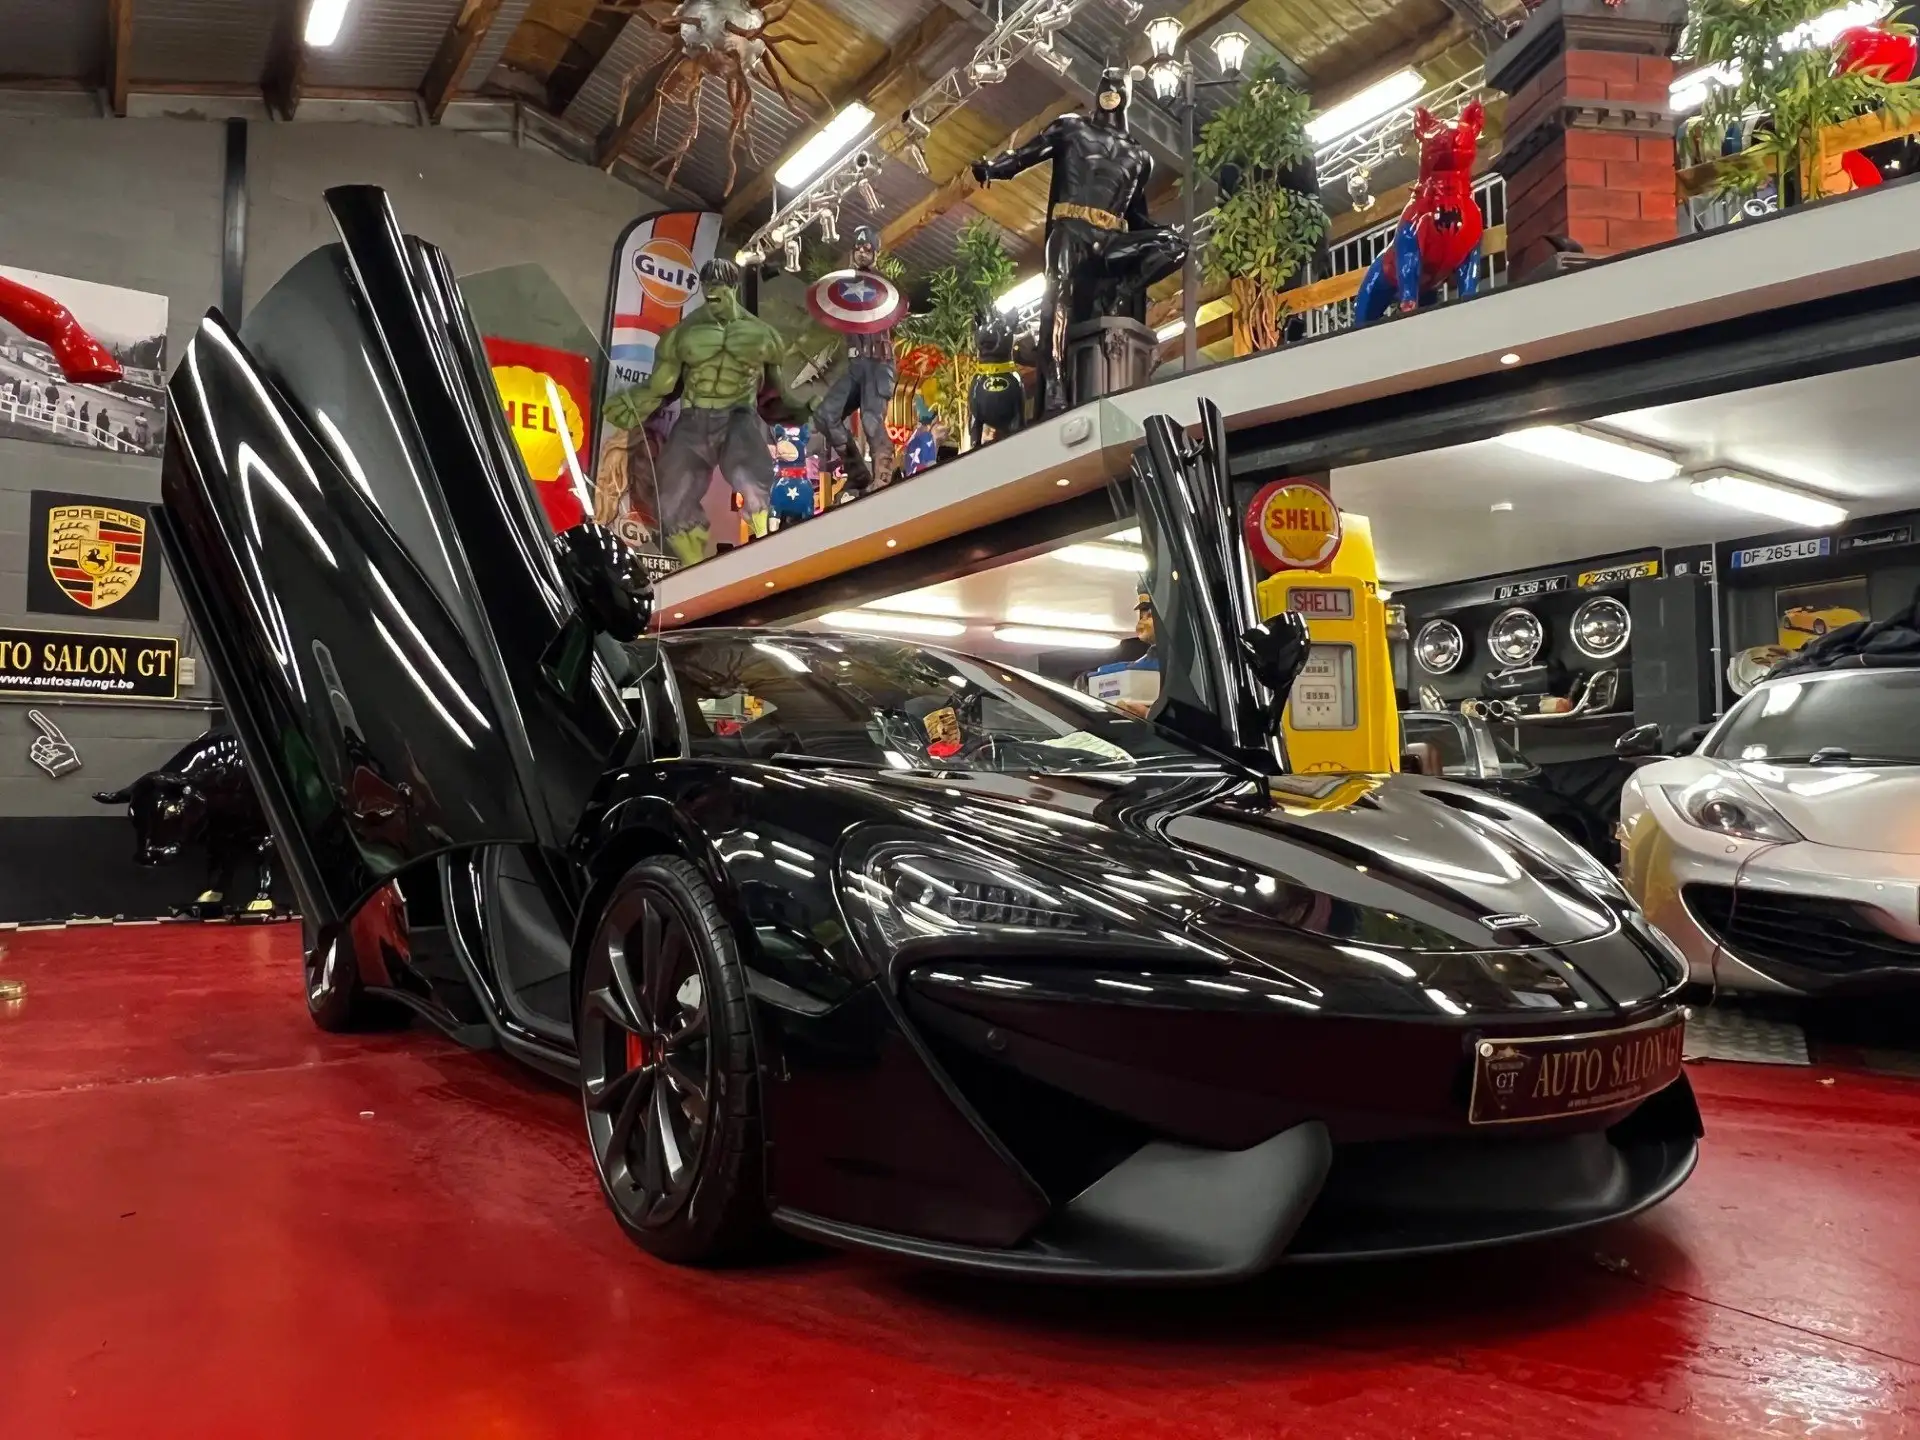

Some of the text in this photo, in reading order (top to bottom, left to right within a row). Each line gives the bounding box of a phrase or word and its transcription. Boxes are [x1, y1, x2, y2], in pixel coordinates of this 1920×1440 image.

[634, 254, 698, 291] Gulf
[615, 364, 651, 384] MART
[53, 508, 142, 529] PORSCHE
[1270, 508, 1331, 532] SHELL
[1293, 593, 1344, 612] SHELL
[0, 641, 172, 678] TO SALON GT
[1531, 1048, 1602, 1099] AUTO
[1609, 1033, 1666, 1088] SALON
[1496, 1071, 1520, 1090] GT
